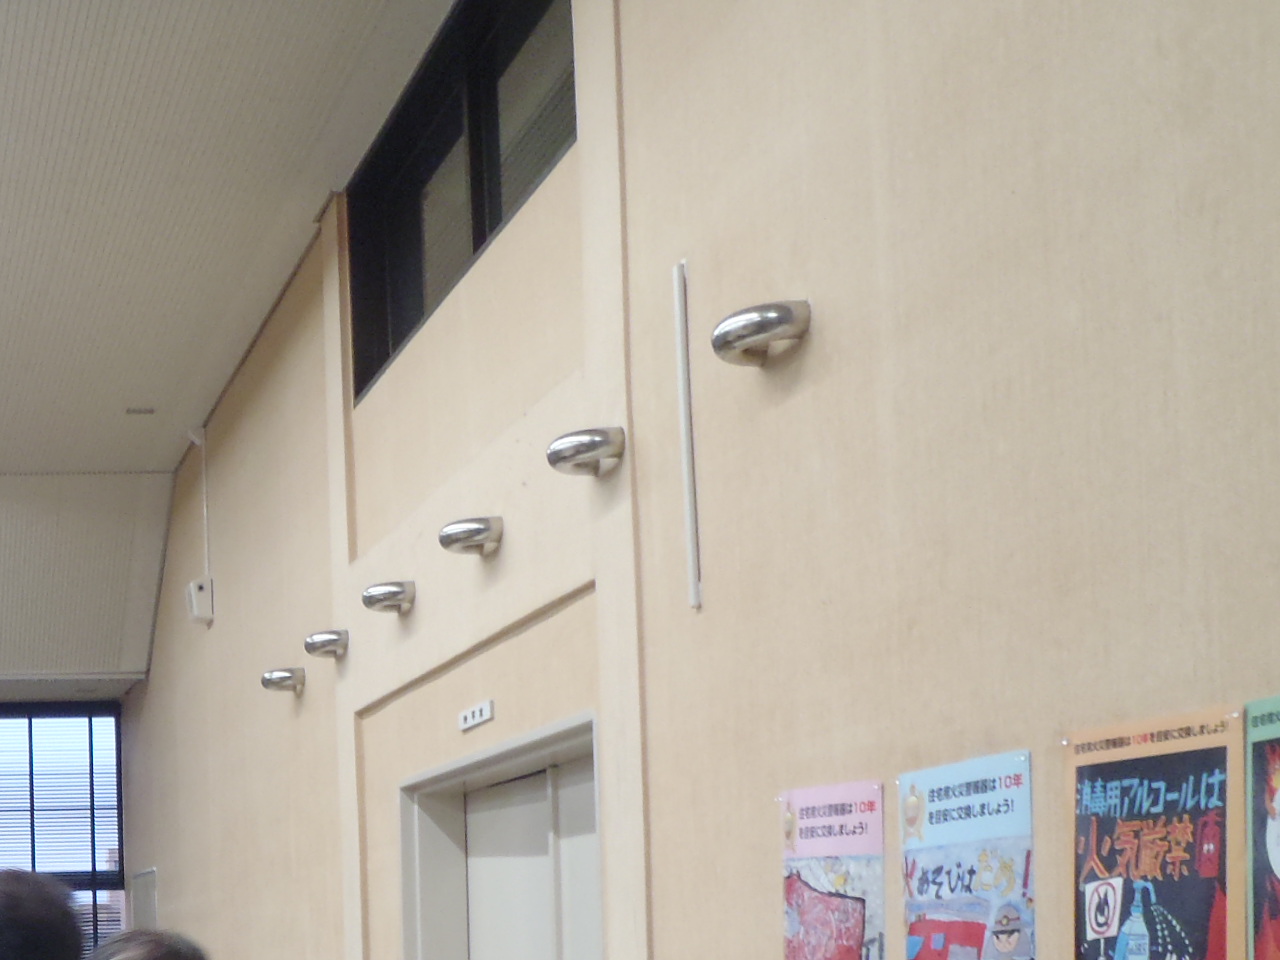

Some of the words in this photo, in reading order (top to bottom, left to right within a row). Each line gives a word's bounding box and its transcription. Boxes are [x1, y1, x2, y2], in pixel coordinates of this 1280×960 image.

[1076, 769, 1226, 817] 消毒用アルコールは
[1077, 813, 1194, 881] 火気厳禁
